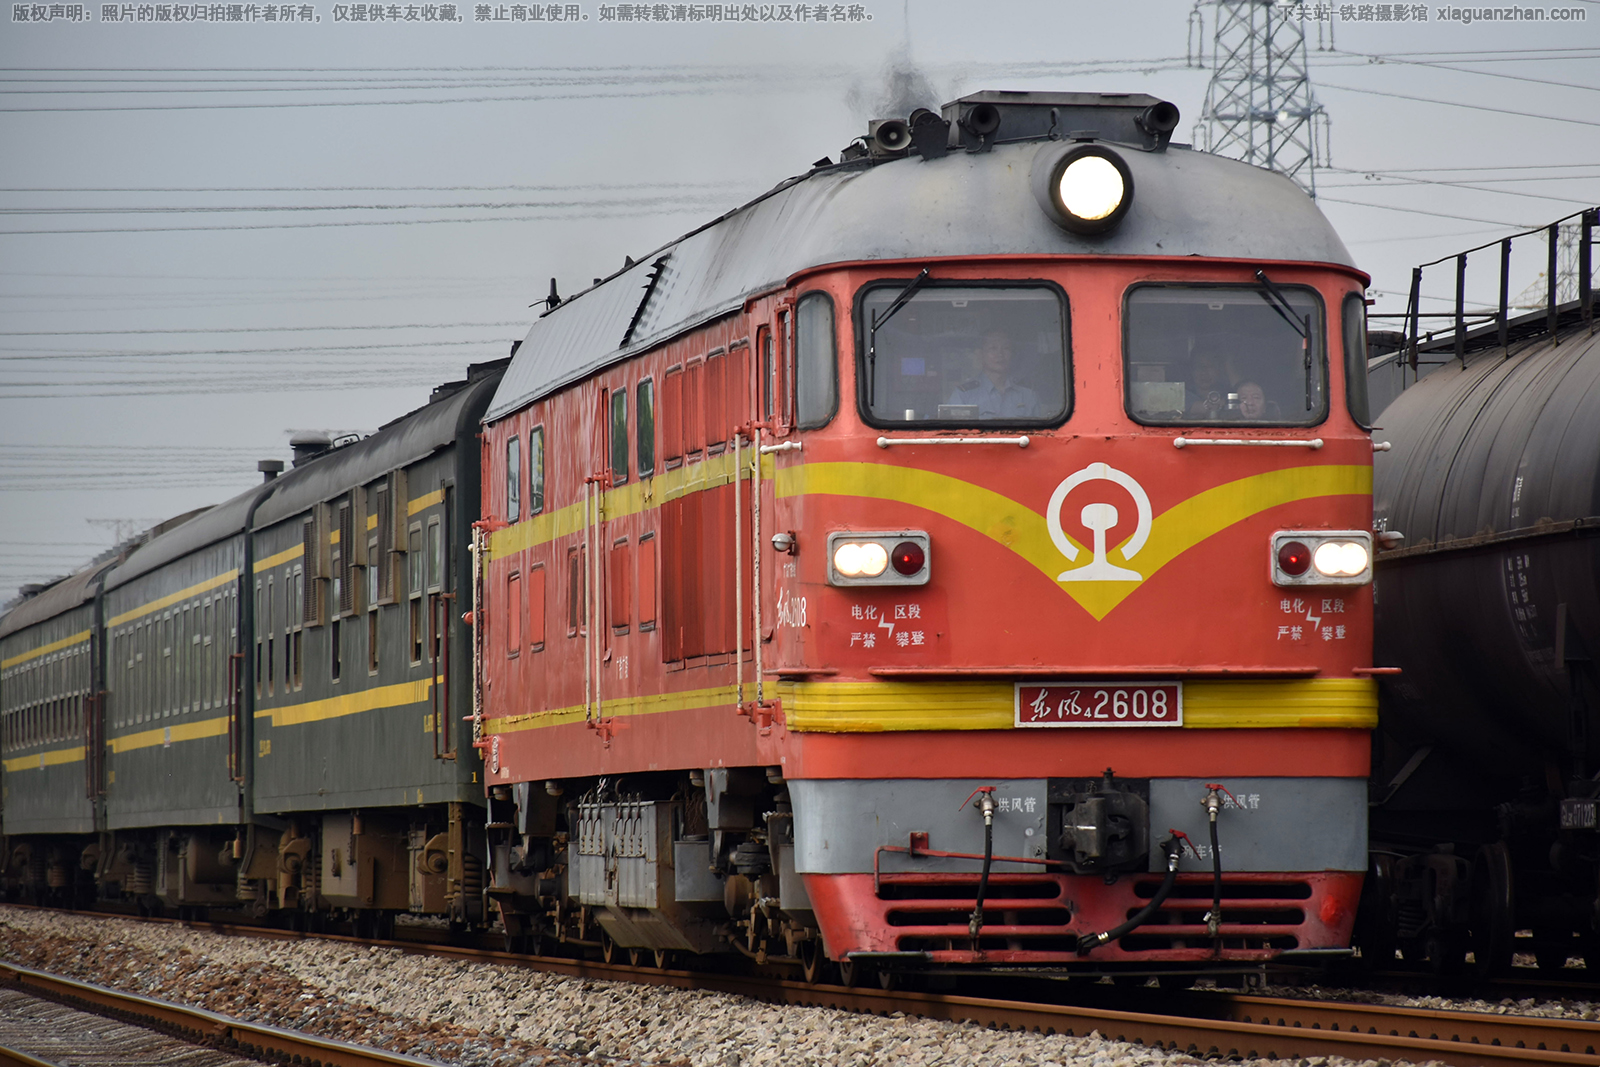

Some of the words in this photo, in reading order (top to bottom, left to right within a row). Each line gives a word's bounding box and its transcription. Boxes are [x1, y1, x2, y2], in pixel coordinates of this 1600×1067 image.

[851, 604, 878, 620] 电化
[894, 604, 921, 619] 区段
[1280, 598, 1305, 613] 电化
[1321, 598, 1345, 613] 区段
[850, 632, 876, 648] 严禁
[895, 631, 925, 647] 攀登
[1277, 625, 1303, 640] 严禁
[1321, 625, 1346, 641] 攀登
[998, 796, 1036, 813] 供风管
[1223, 793, 1260, 809] 供风管
